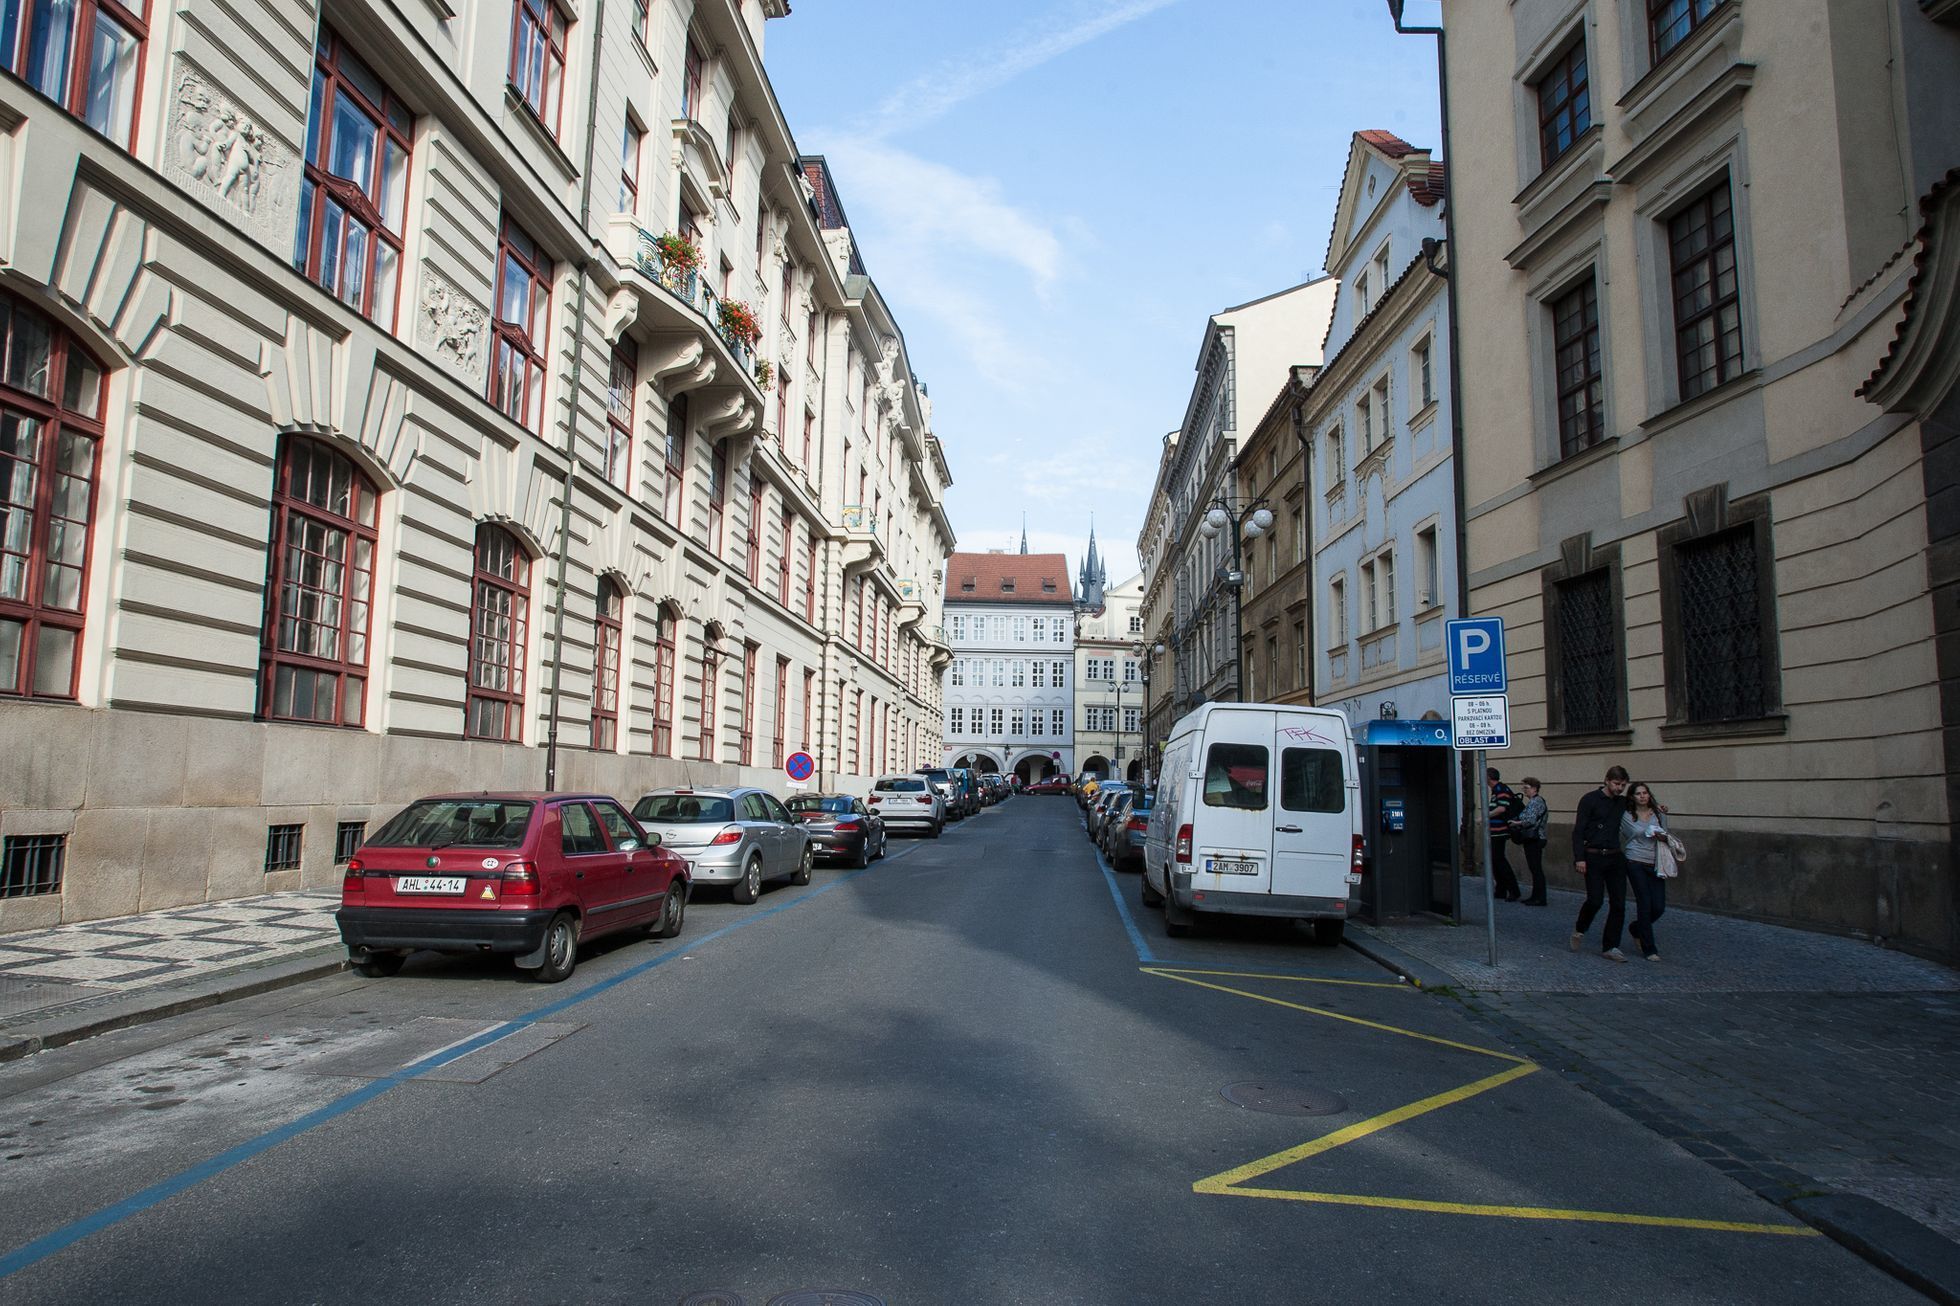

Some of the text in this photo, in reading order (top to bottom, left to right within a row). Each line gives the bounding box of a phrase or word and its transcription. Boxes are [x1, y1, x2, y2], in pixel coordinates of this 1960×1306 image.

[1459, 628, 1491, 670] P
[1454, 672, 1501, 684] RÉSERVÉ
[1459, 736, 1489, 744] OBLAST
[1213, 862, 1254, 873] 2AM 3907
[402, 878, 421, 890] AHL
